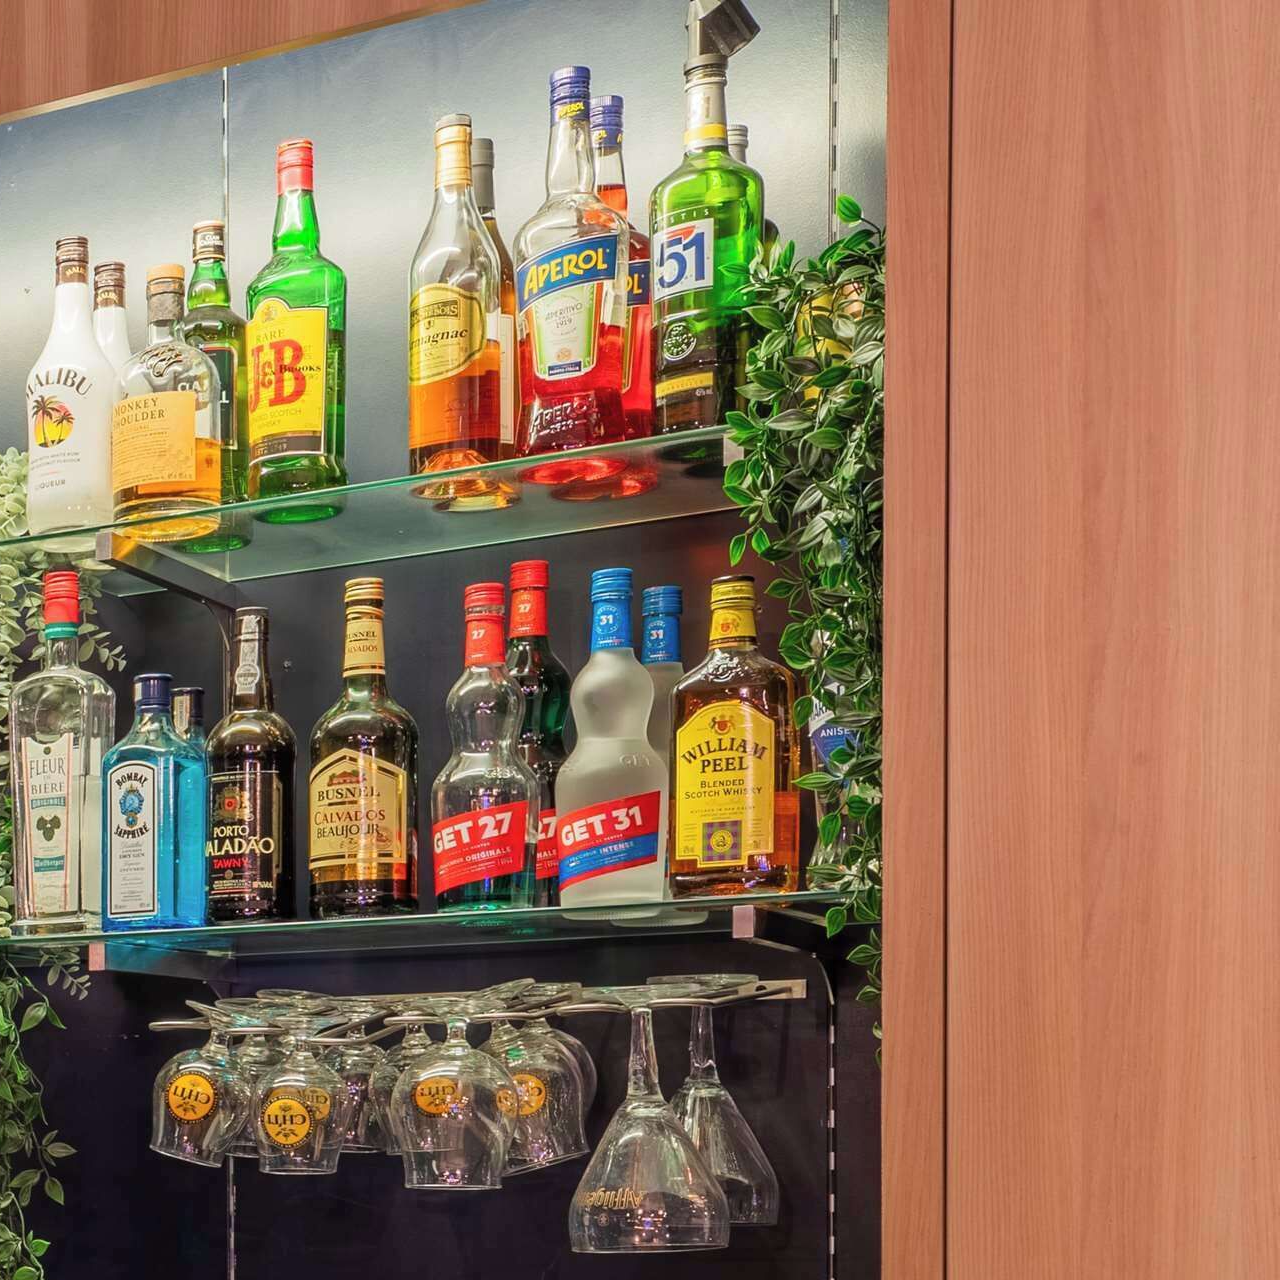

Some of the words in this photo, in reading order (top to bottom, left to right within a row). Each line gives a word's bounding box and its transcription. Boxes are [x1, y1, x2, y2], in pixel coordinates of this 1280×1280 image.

[658, 232, 705, 288] 51
[524, 247, 607, 299] APEROL
[545, 302, 583, 320] APERITIVO
[26, 367, 93, 399] MALIBU
[113, 397, 160, 418] MONKEY
[518, 604, 531, 613] 27
[600, 615, 613, 625] 31
[472, 629, 486, 640] 27
[650, 630, 663, 639] 31
[681, 737, 768, 764] WILLIAM
[30, 757, 65, 778] FLEUR
[700, 756, 748, 774] PEEL
[115, 772, 148, 788] BOMBAY
[700, 778, 745, 788] BLENDED
[317, 785, 381, 802] BUSNEL
[684, 789, 720, 800] SCOTCH
[314, 808, 385, 825] CALVADOS
[114, 821, 149, 839] SAPPHIRE
[213, 825, 249, 838] PORTO
[317, 823, 381, 840] BEAUJOUR
[434, 820, 473, 854] GET
[478, 811, 512, 839] 27
[562, 813, 606, 846] GET
[612, 805, 642, 831] 31
[465, 847, 511, 862] ORIGINALE
[599, 841, 634, 855] INTENSE
[212, 857, 250, 869] TAWNY
